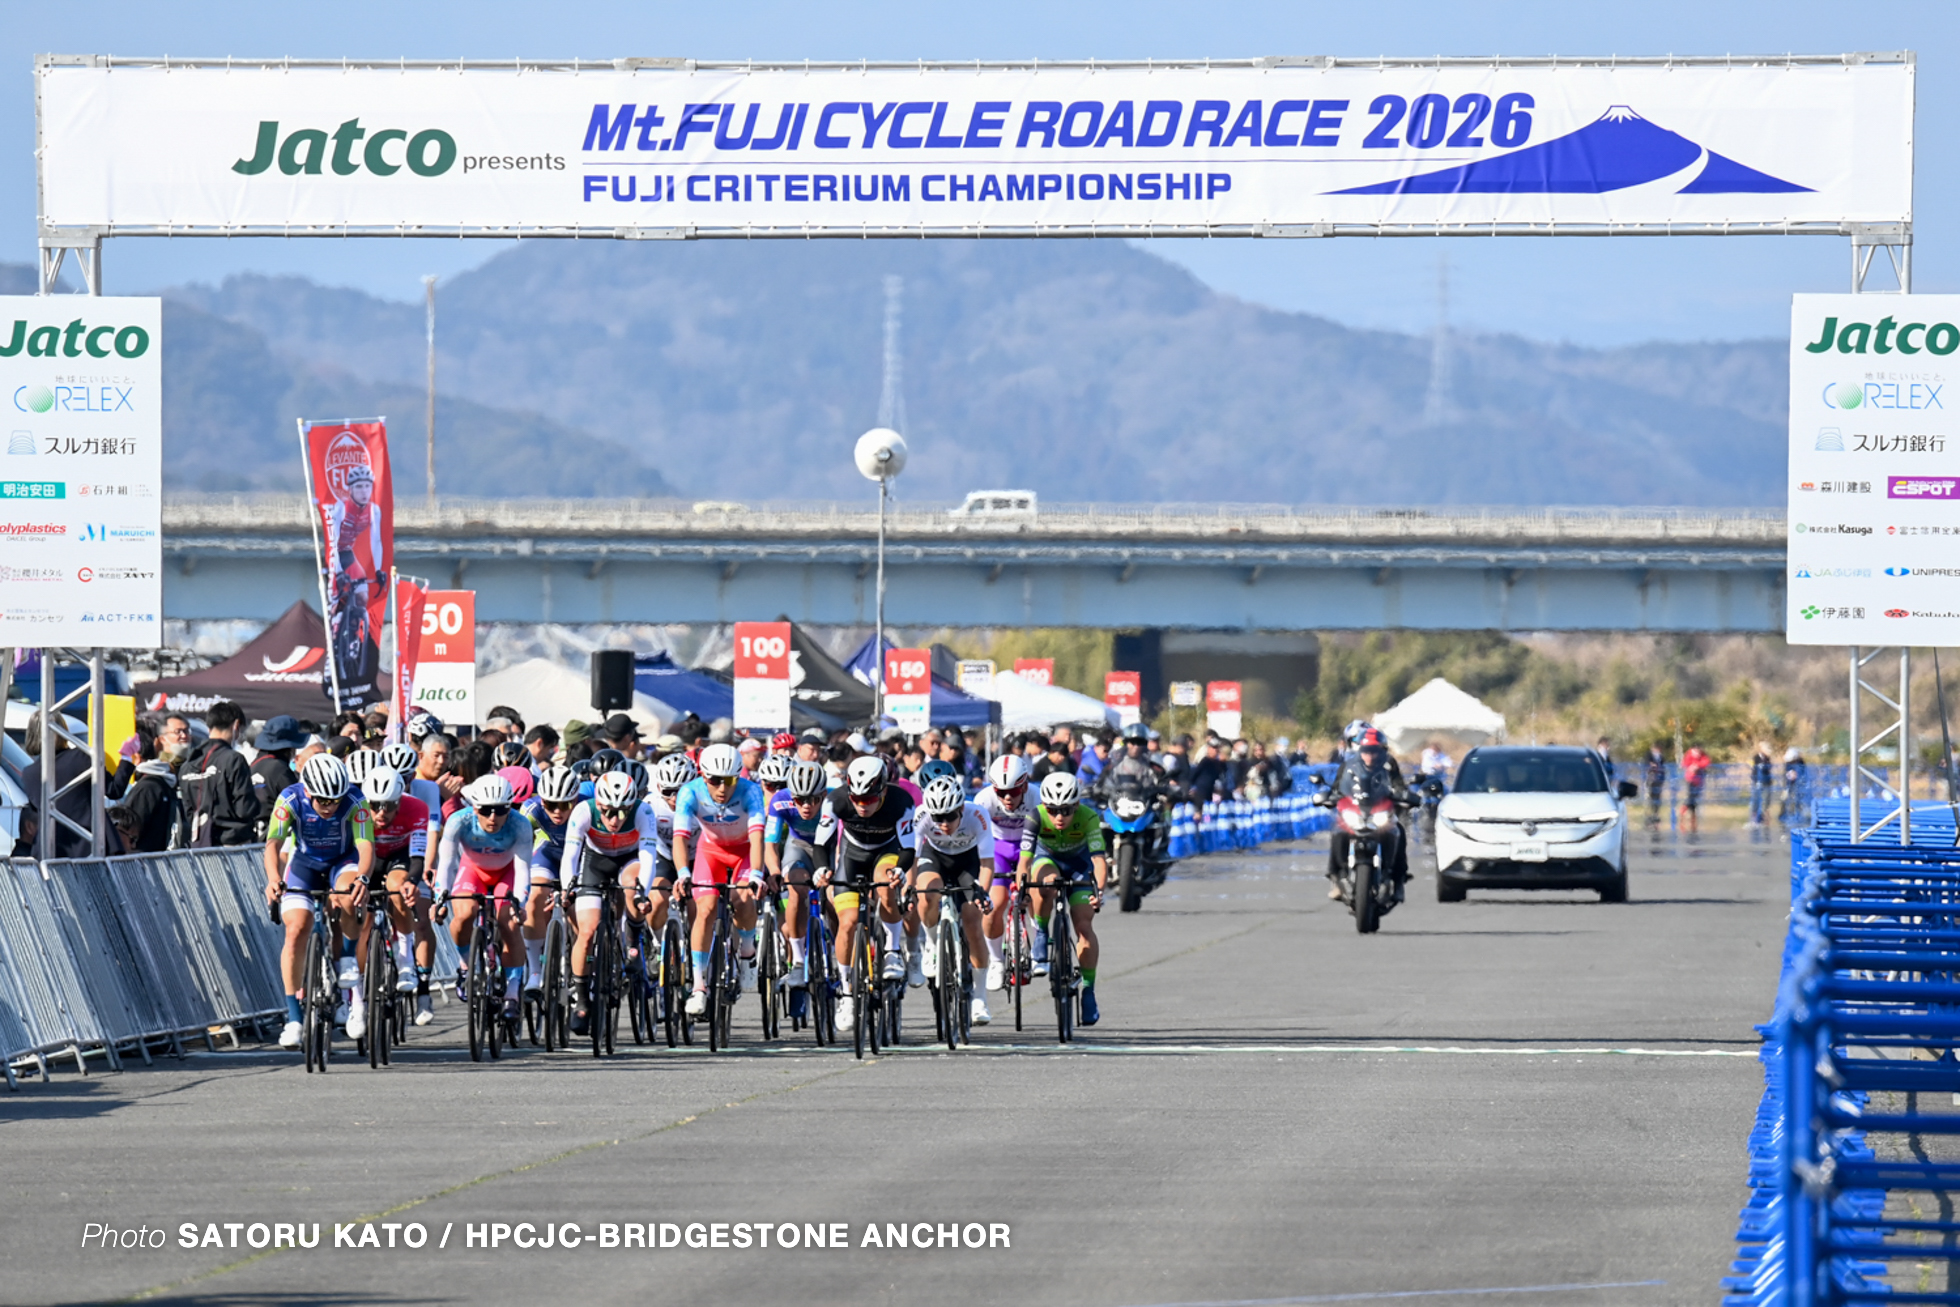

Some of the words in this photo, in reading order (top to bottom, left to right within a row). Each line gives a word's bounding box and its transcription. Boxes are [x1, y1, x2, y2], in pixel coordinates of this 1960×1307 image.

[582, 102, 809, 151] Mt.FUJI
[814, 101, 1010, 149] CYCLE
[1361, 93, 1535, 150] 2026
[231, 117, 457, 177] Jatco
[463, 152, 566, 174] presents
[583, 175, 674, 202] FUJI
[686, 174, 911, 202] CRITERIUM
[921, 172, 1231, 201] CHAMPIONSHIP
[0, 318, 149, 359] Jatco
[1805, 315, 1960, 356] Jatco
[13, 385, 134, 413] CORELEX
[1822, 382, 1944, 410] CORELEX
[44, 437, 137, 455] スルガ銀行
[1853, 434, 1946, 453] スルガ銀行
[3, 483, 56, 497] 明治安田
[93, 484, 128, 496] 石井組
[1820, 481, 1872, 494] 森川建設
[0, 523, 66, 535] olyplastics
[1838, 524, 1873, 536] Kasuga
[1912, 568, 1960, 577] UNIPRES
[421, 603, 463, 635] 50
[1822, 606, 1866, 620] 伊藤園
[434, 642, 447, 655] m
[740, 636, 786, 659] 100
[889, 660, 926, 678] 150
[165, 692, 233, 713] vittor
[415, 686, 467, 702] Jatco
